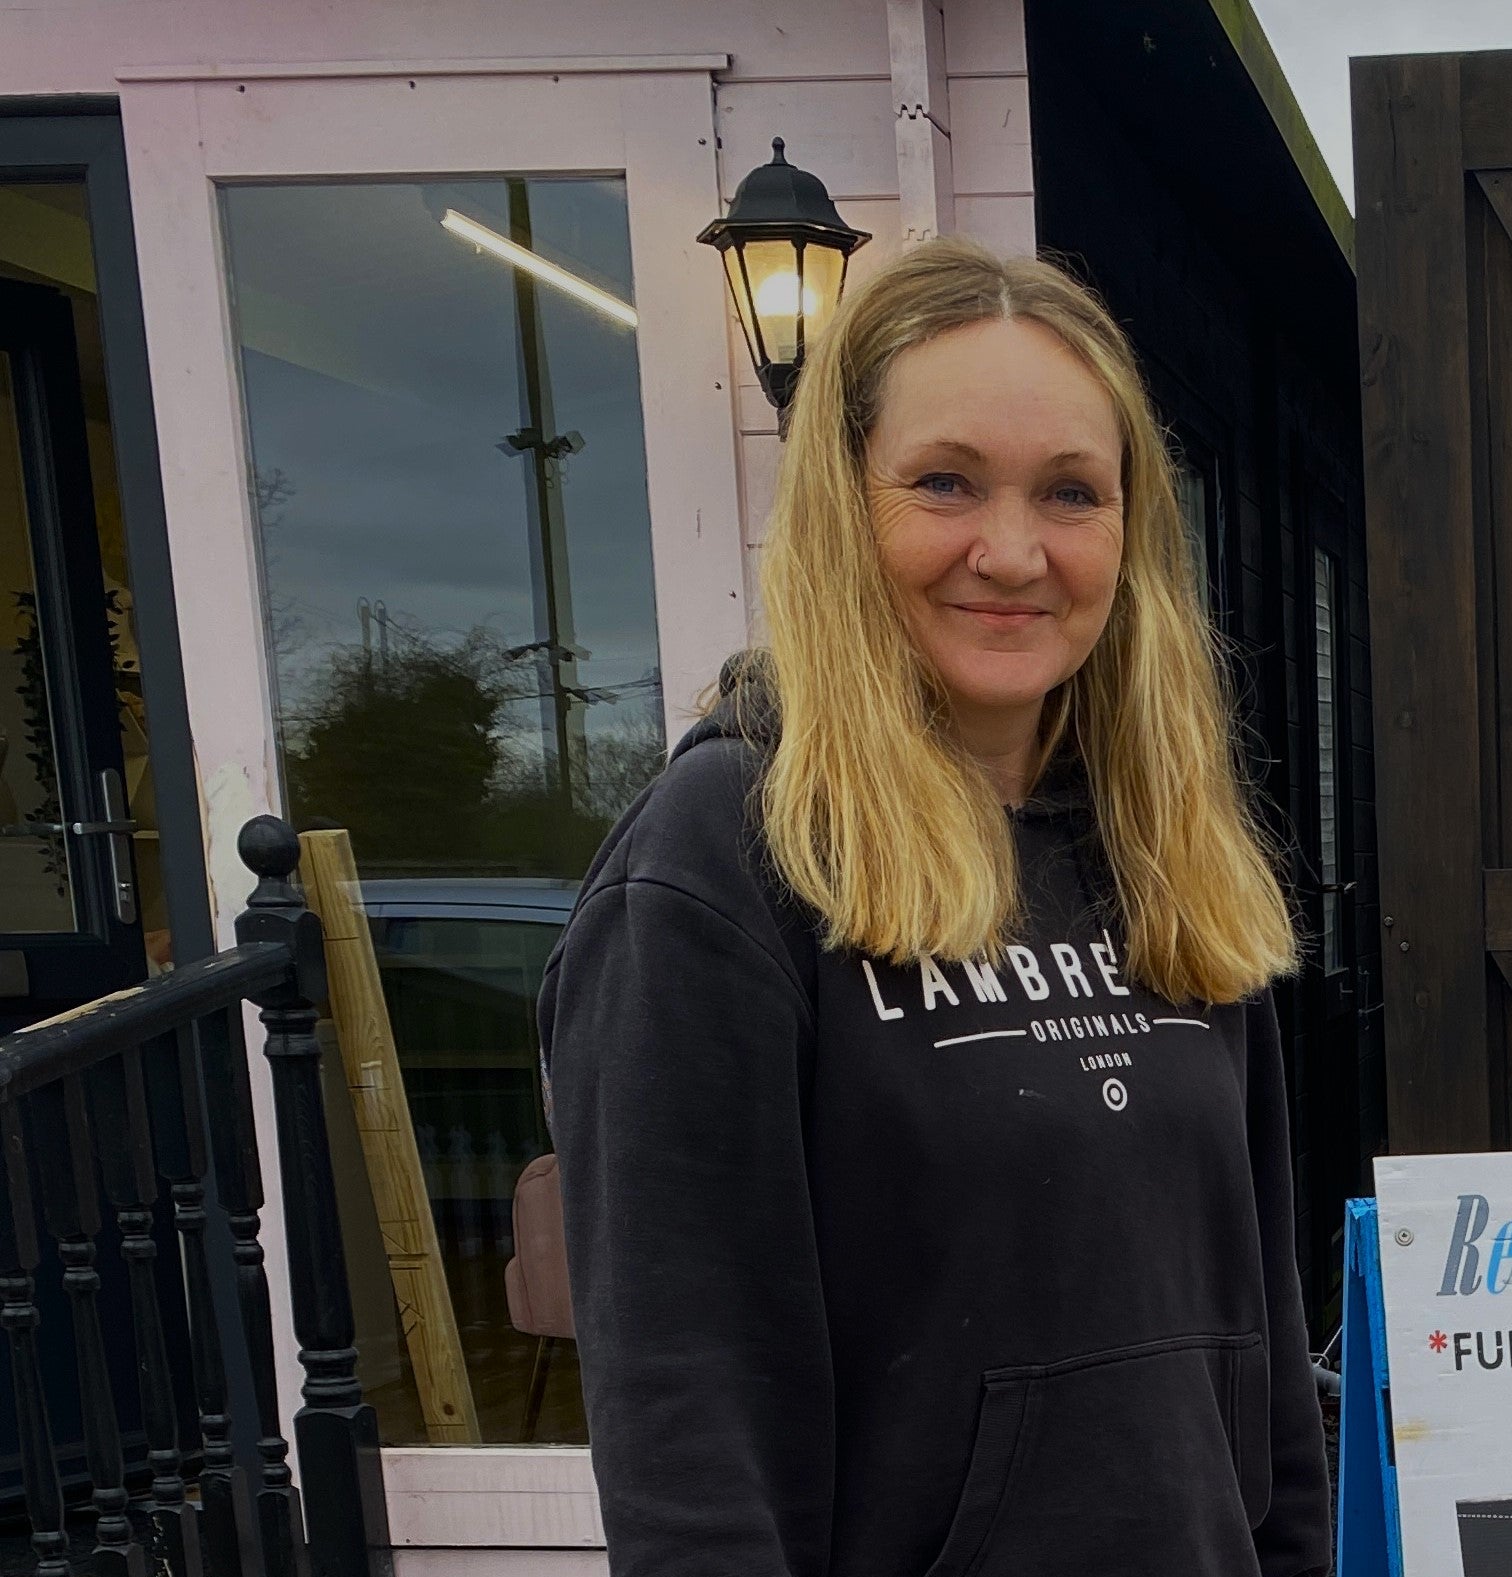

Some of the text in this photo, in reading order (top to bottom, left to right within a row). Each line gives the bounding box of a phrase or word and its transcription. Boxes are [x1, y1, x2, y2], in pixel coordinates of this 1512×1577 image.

[862, 943, 1130, 1021] LAMBRE
[1030, 1012, 1151, 1042] ORIGINALS
[1080, 1051, 1132, 1072] LONDON
